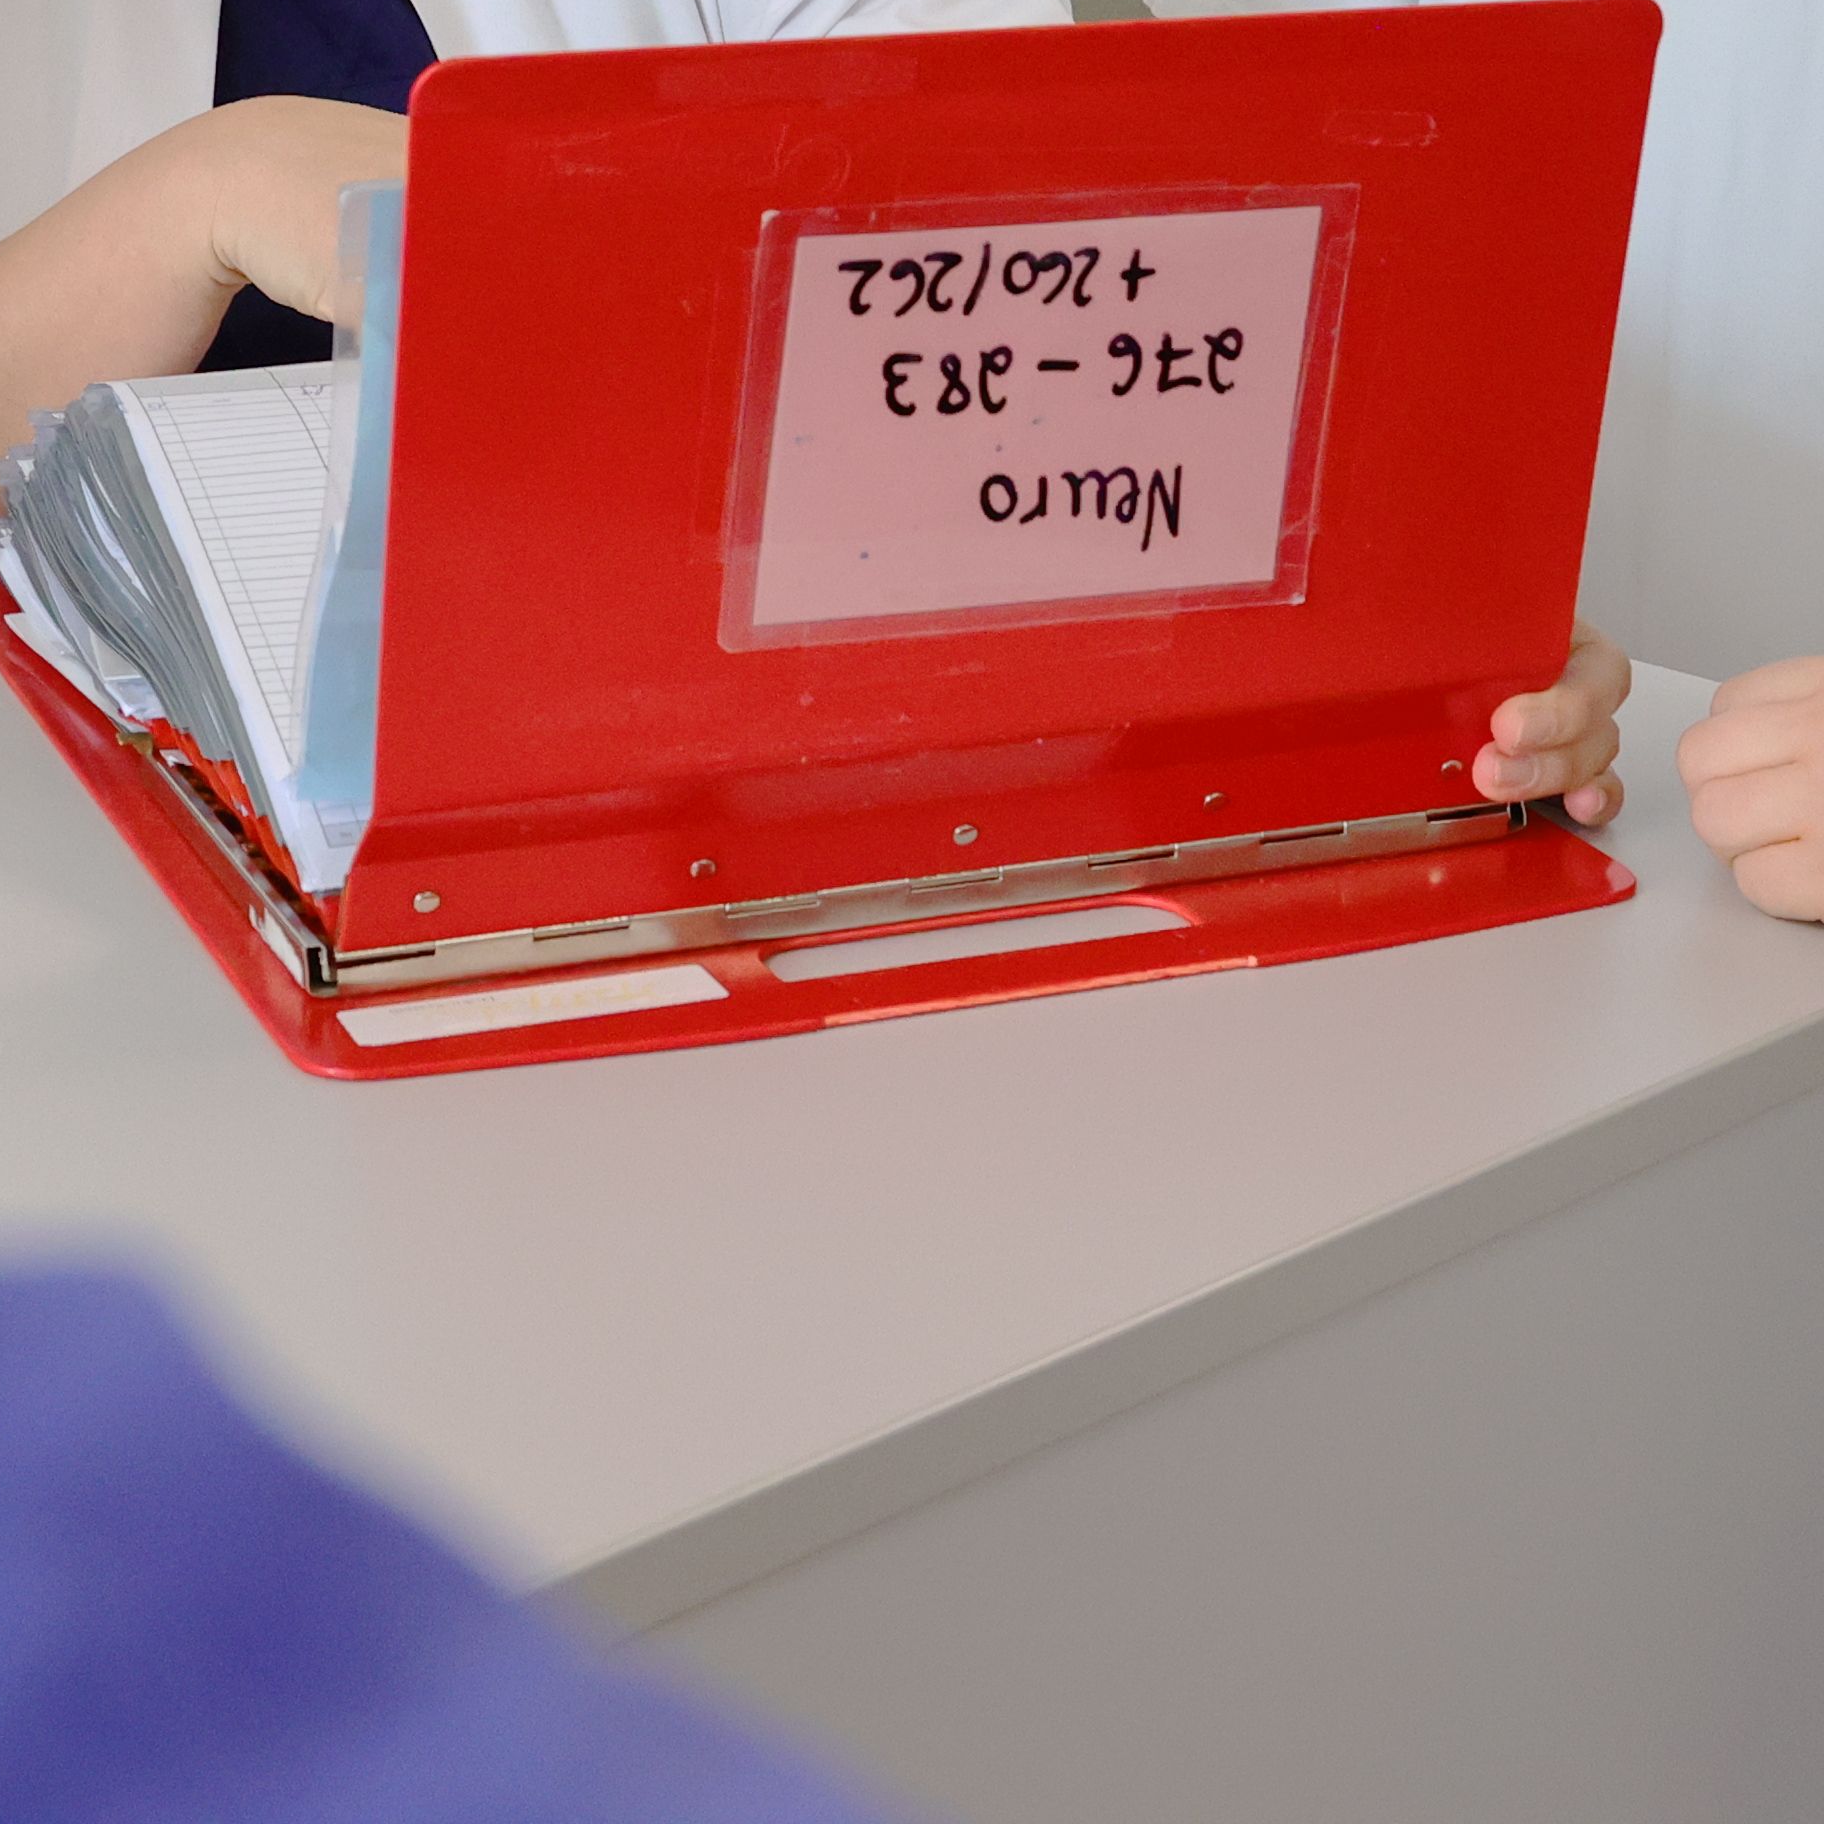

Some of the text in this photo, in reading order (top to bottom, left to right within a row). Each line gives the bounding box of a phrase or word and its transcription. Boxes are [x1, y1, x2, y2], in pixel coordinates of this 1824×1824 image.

[881, 344, 1014, 418] 283
[1107, 326, 1244, 398] 276
[979, 464, 1183, 553] Neuro
